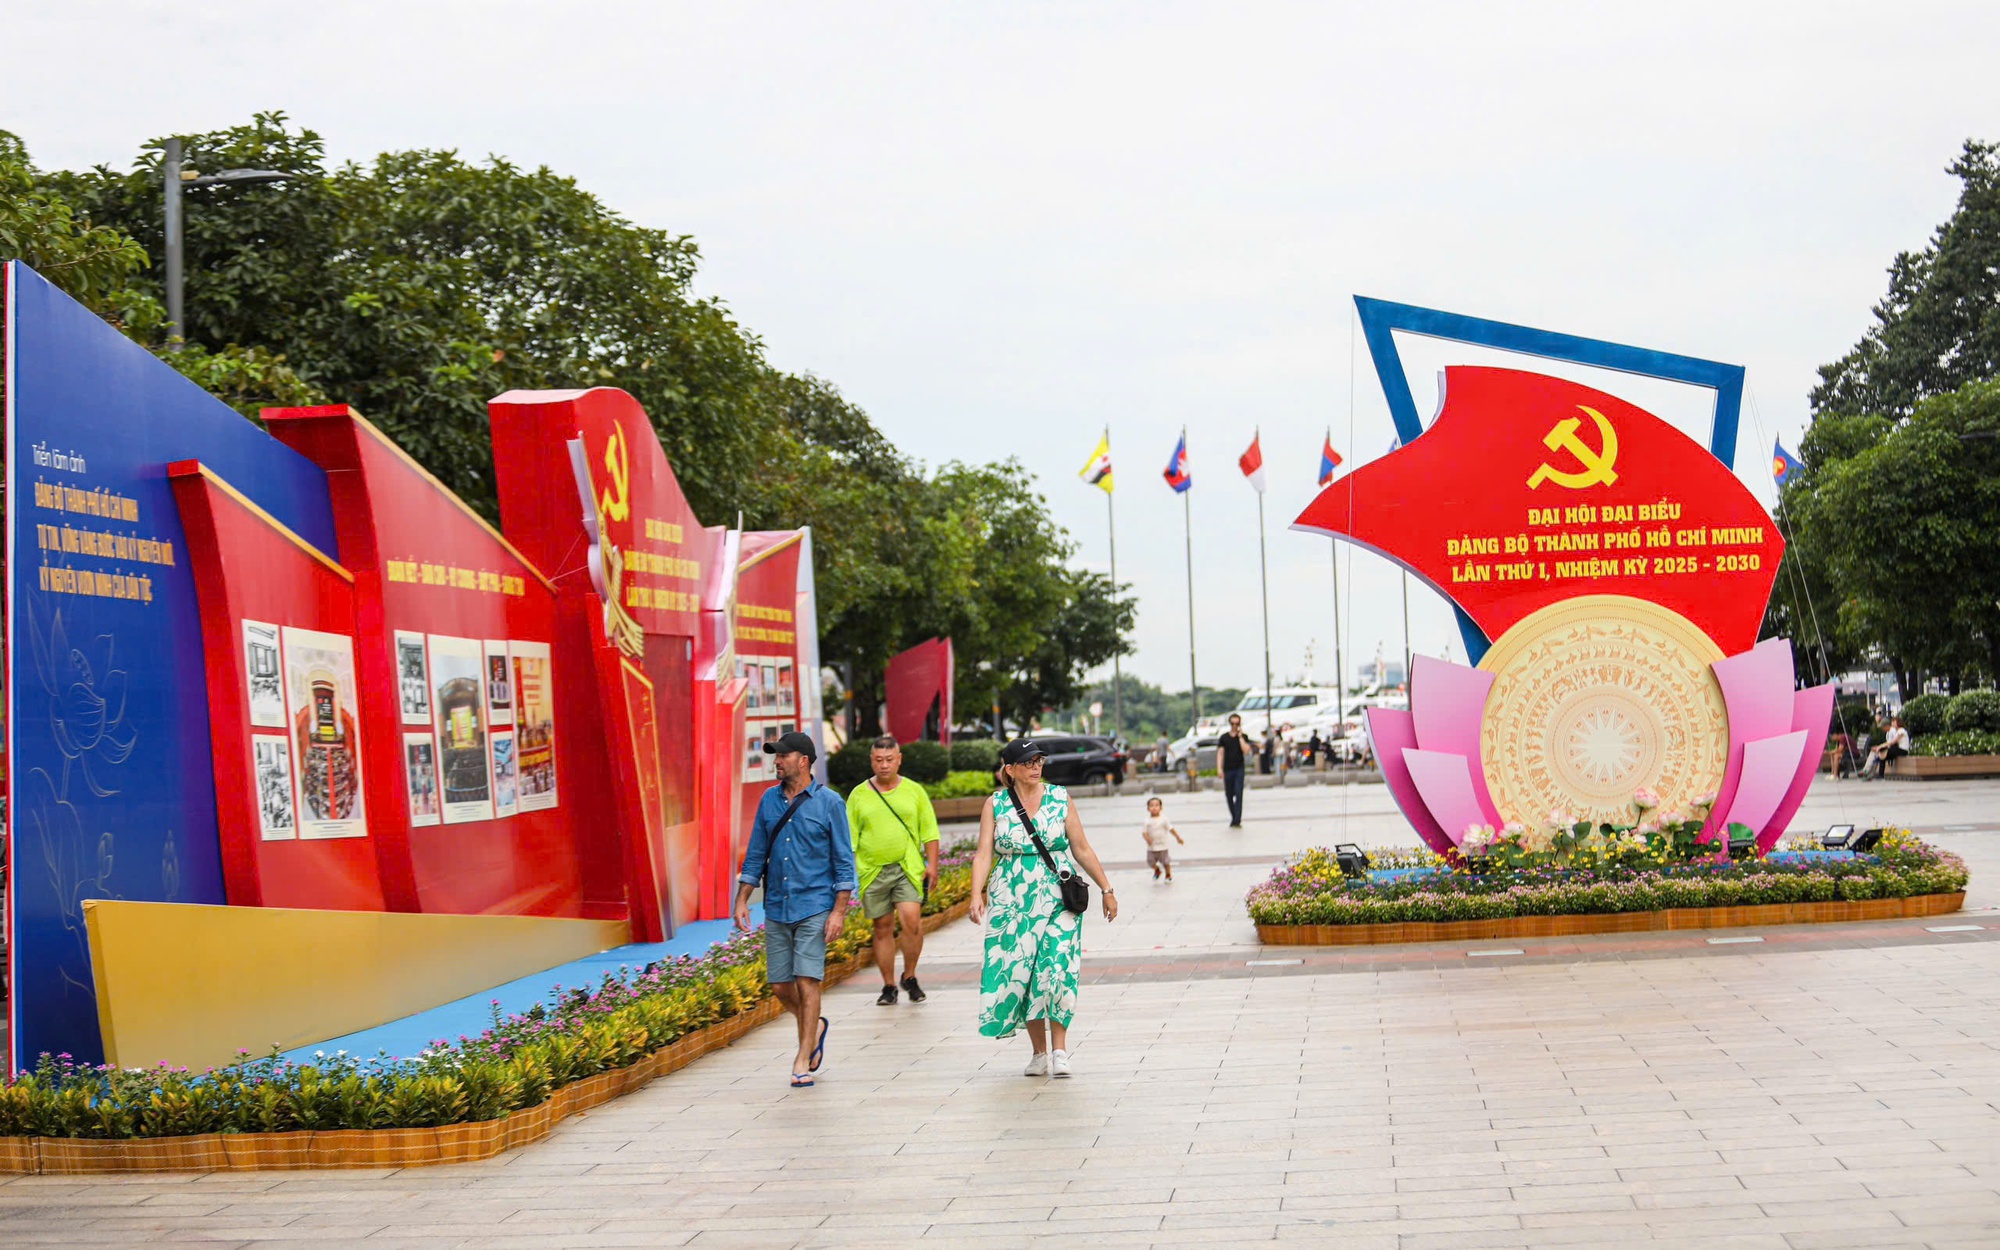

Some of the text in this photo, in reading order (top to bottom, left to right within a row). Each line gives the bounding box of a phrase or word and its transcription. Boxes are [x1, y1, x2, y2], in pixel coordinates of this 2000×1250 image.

[1527, 497, 1681, 528] ĐẠI HỘI ĐẠI BIỂU
[1447, 524, 1764, 556] ĐẢNG BỘ THÀNH PHỐ HỒ CHÍ MINH
[1452, 559, 1491, 583] LẦN
[1494, 560, 1535, 581] THỨ
[1538, 562, 1551, 582] I,
[1555, 557, 1619, 580] NHIỆM
[1623, 555, 1648, 576] KỲ
[1653, 556, 1698, 574] 2025
[1716, 554, 1761, 572] 2030
